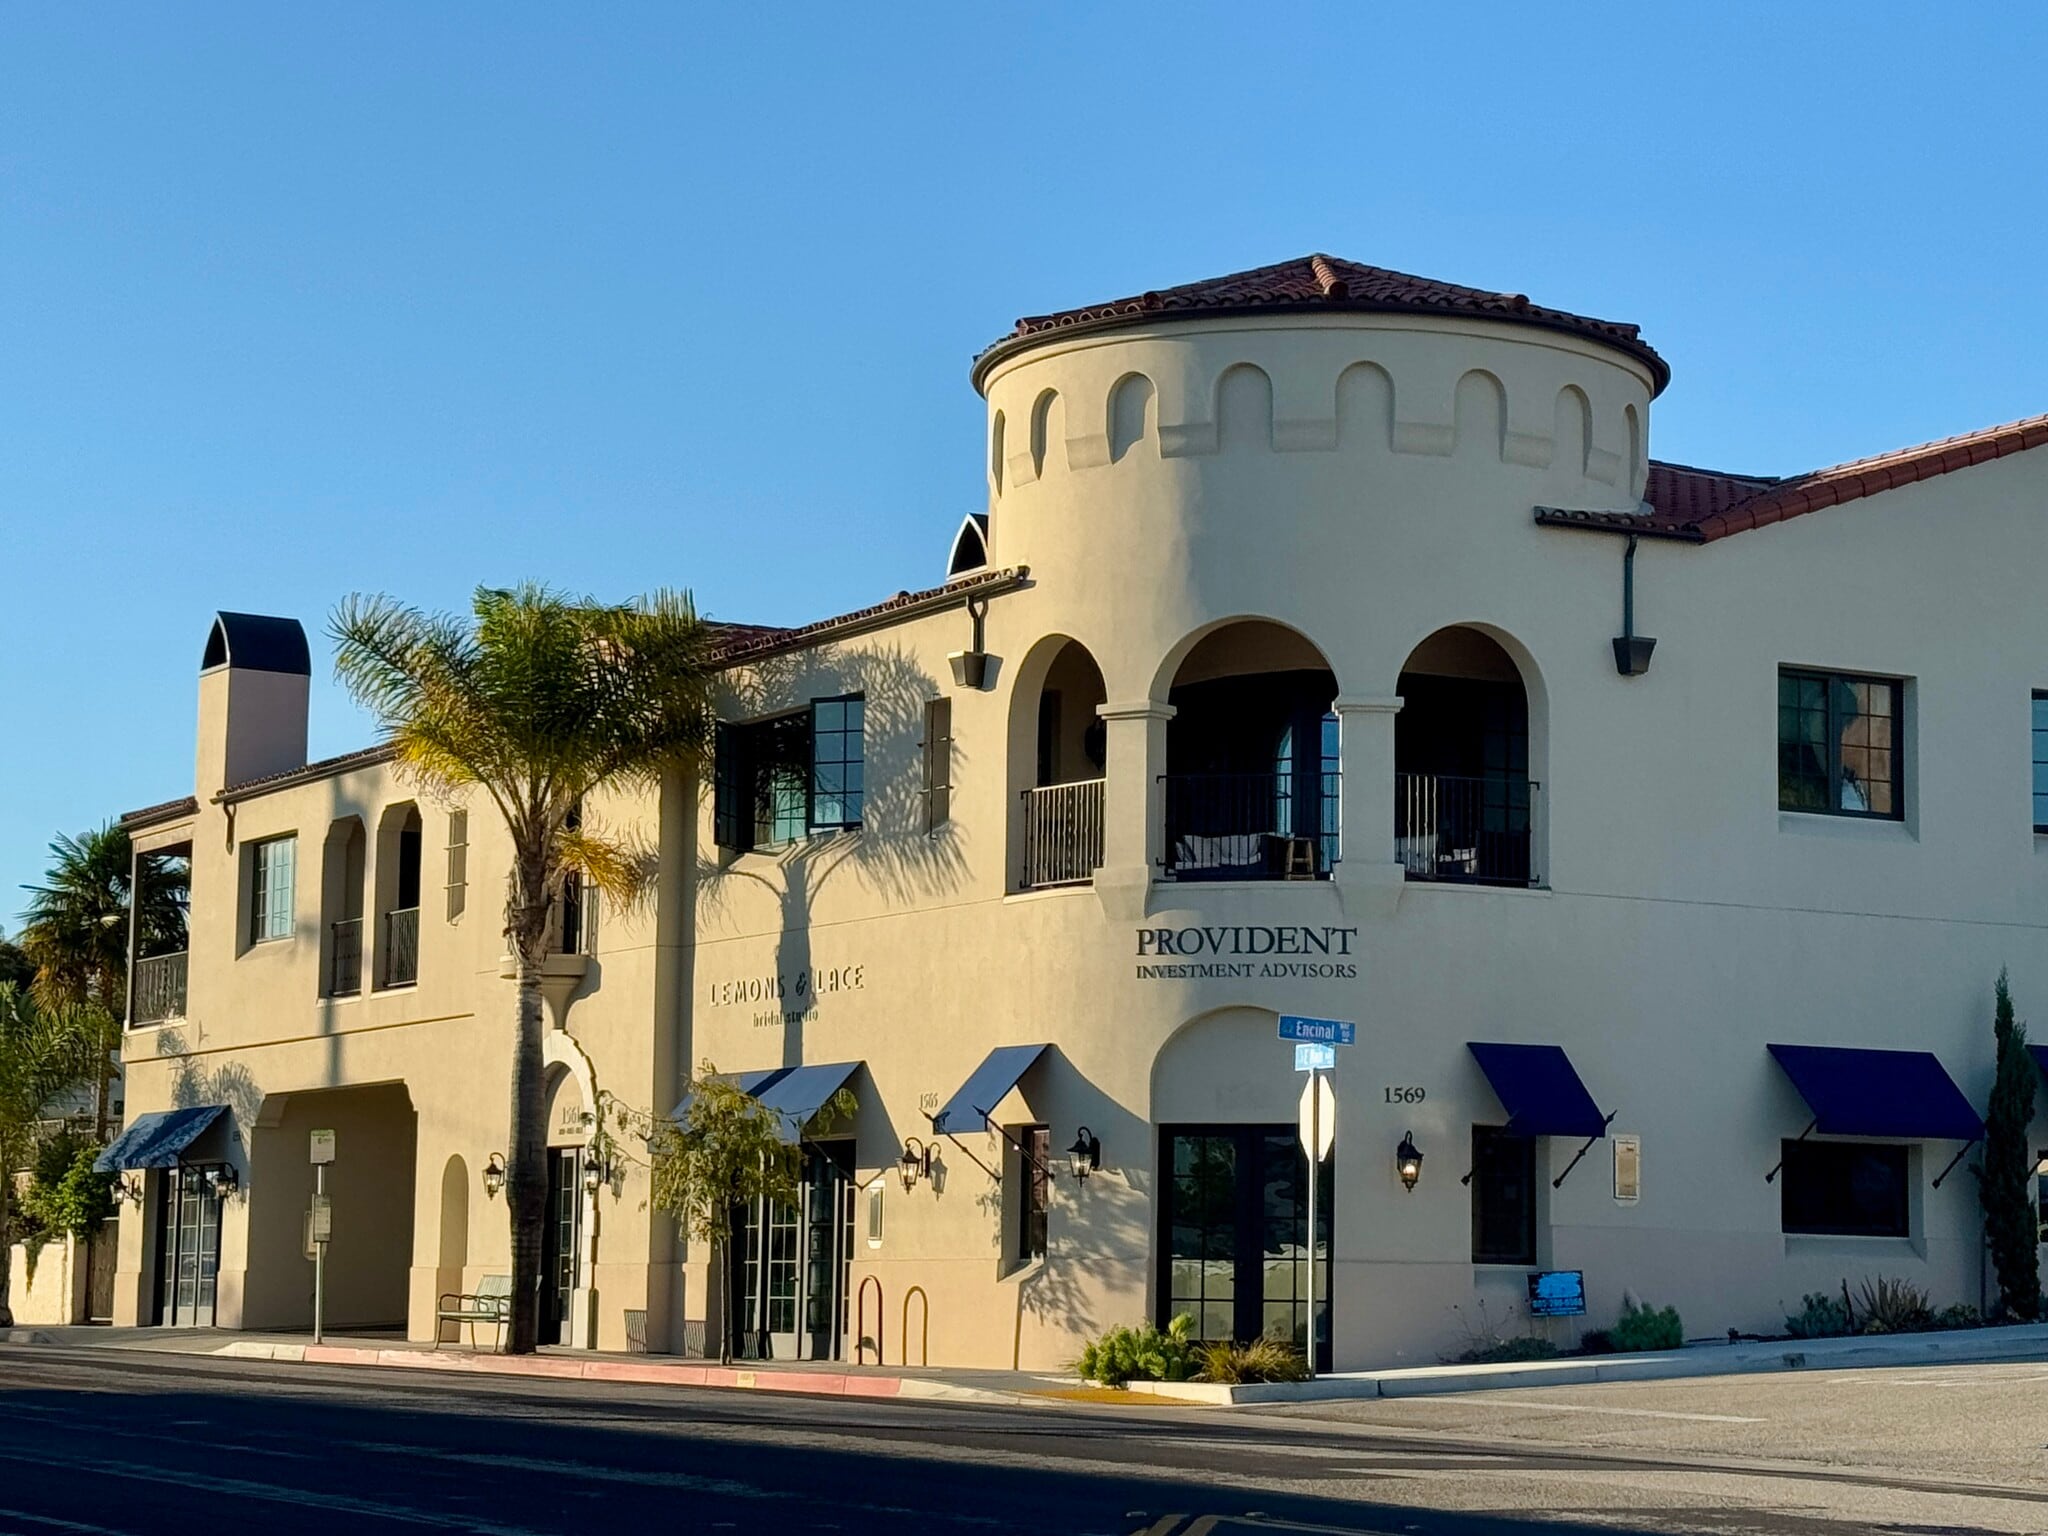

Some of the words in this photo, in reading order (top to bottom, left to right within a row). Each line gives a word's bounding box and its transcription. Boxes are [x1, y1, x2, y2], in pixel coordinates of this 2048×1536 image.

[1136, 927, 1357, 955] PROVIDENT
[1136, 963, 1255, 979] INVESTMENT
[1260, 963, 1357, 979] ADVISORS
[710, 975, 786, 1008] LEMONS
[795, 972, 808, 997] &
[816, 964, 865, 994] LACE
[1296, 1020, 1335, 1040] Encinal
[1384, 1086, 1426, 1104] 1569
